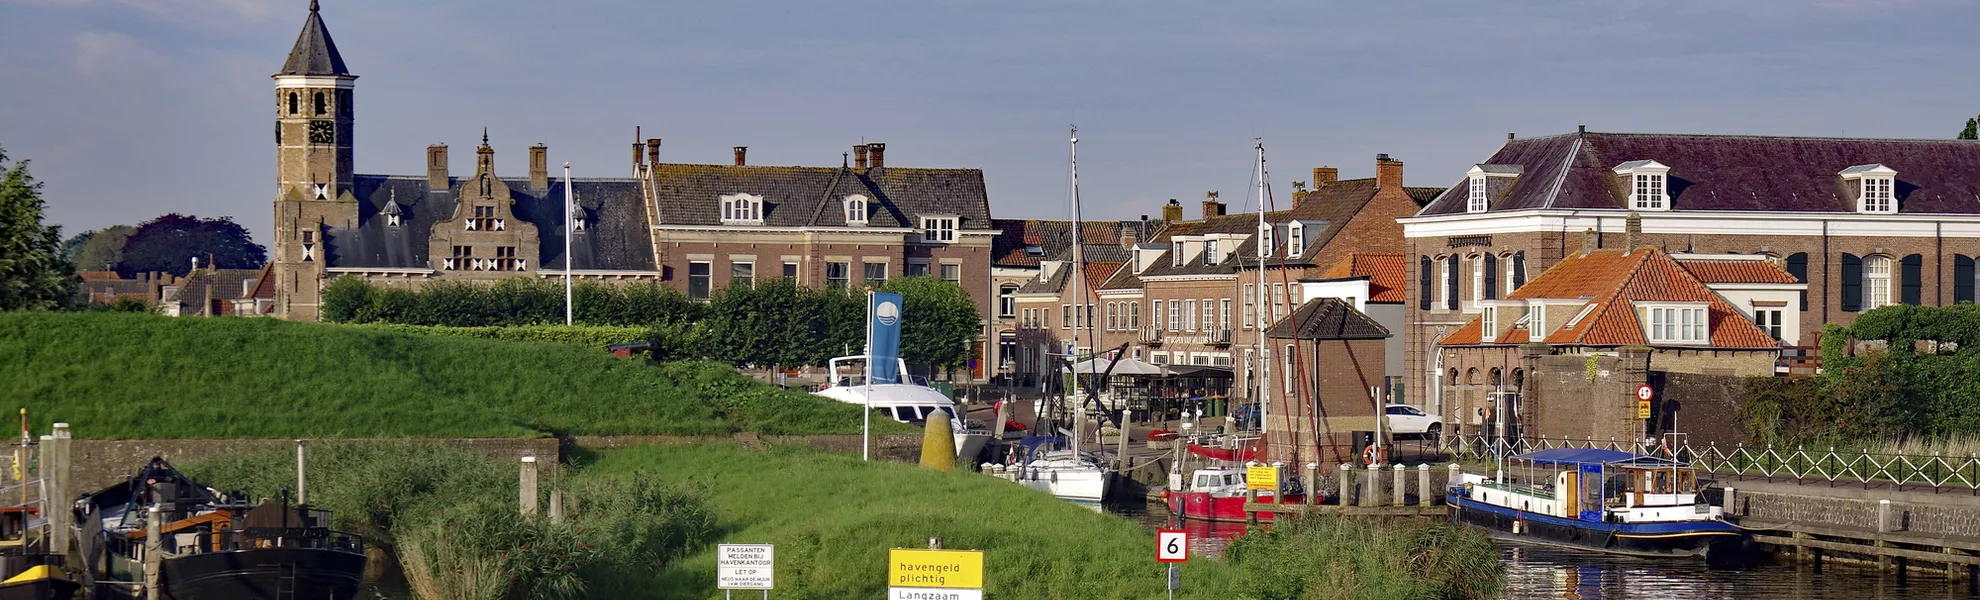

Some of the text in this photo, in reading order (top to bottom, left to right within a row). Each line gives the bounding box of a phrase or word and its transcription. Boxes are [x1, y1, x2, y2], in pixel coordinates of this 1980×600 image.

[1167, 537, 1178, 554] 6
[900, 562, 960, 574] havengeld
[900, 574, 945, 585] plichtig
[900, 590, 959, 600] Langzaam
